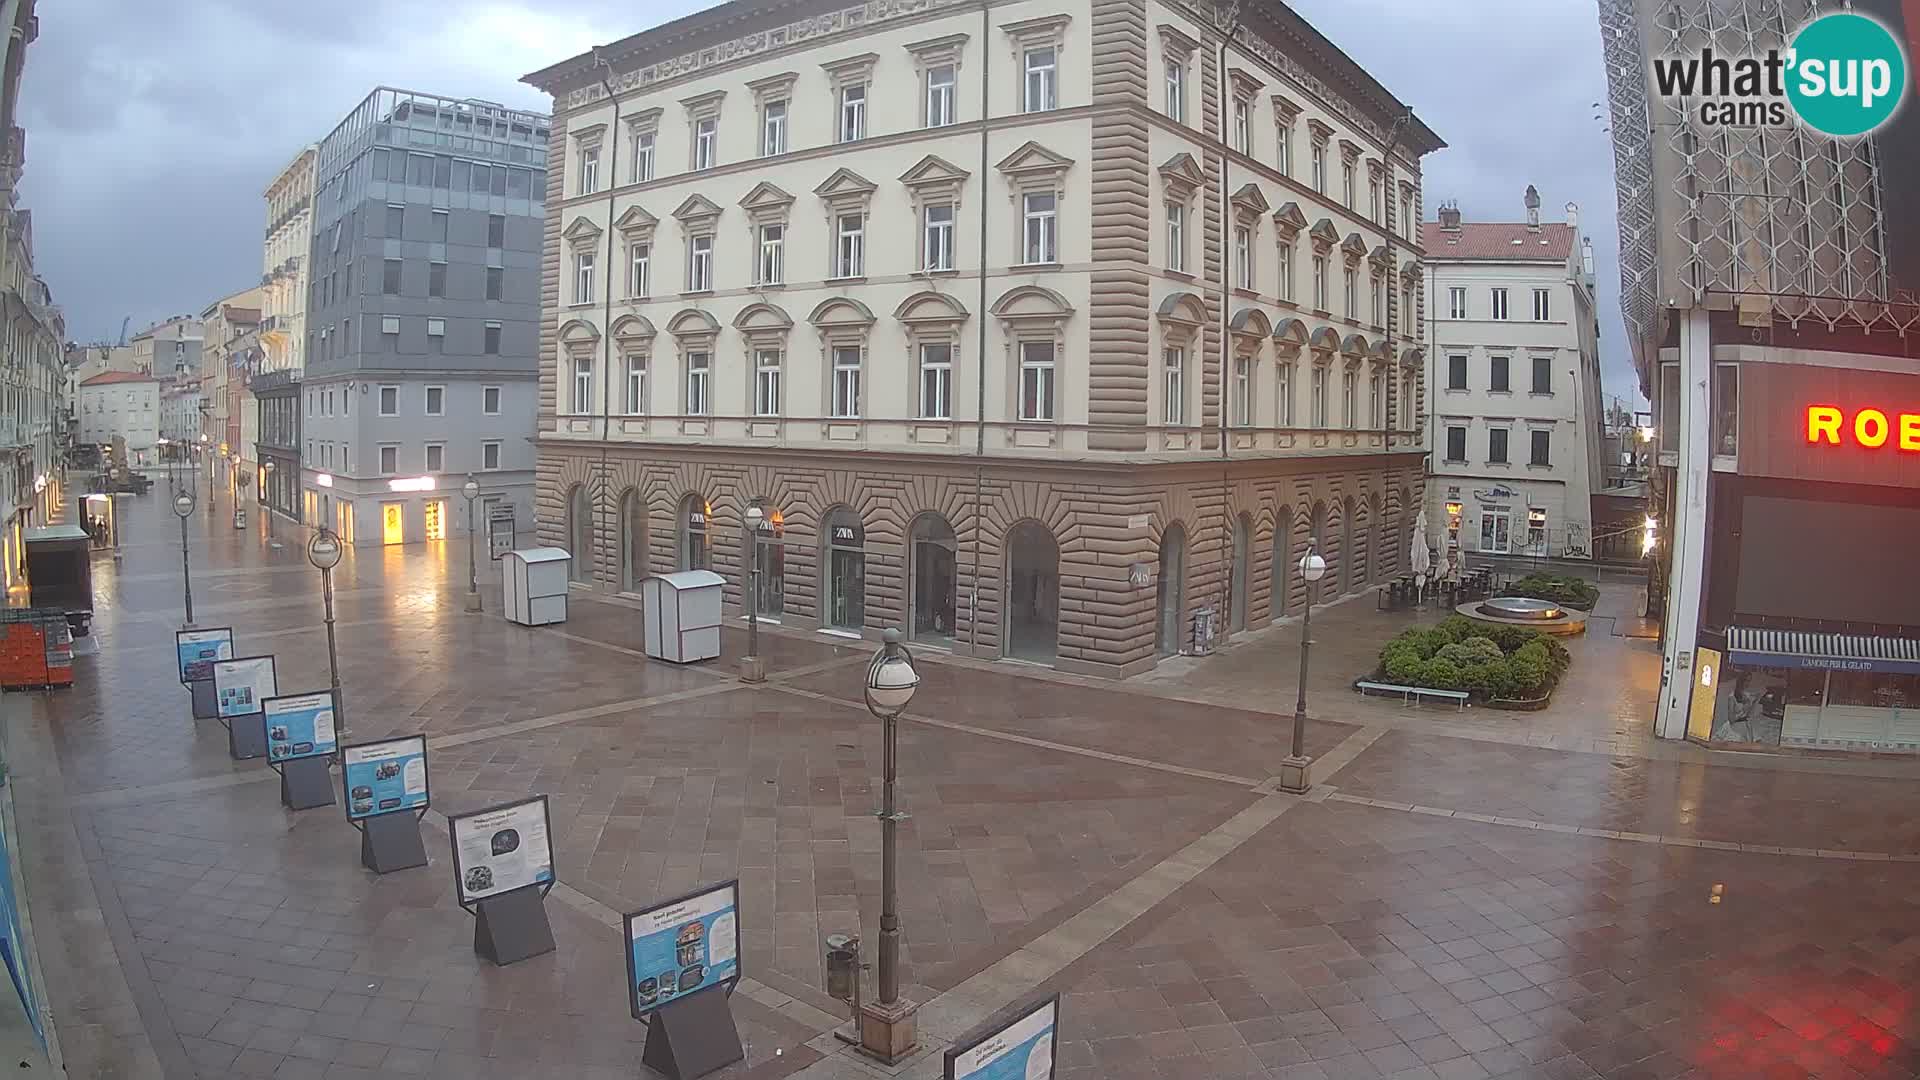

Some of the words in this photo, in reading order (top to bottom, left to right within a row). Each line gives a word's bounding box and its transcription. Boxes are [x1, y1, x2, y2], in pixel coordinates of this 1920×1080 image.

[1801, 657, 1828, 668] L'AMORE
[1829, 659, 1841, 669] PER
[1847, 661, 1872, 670] GELATO
